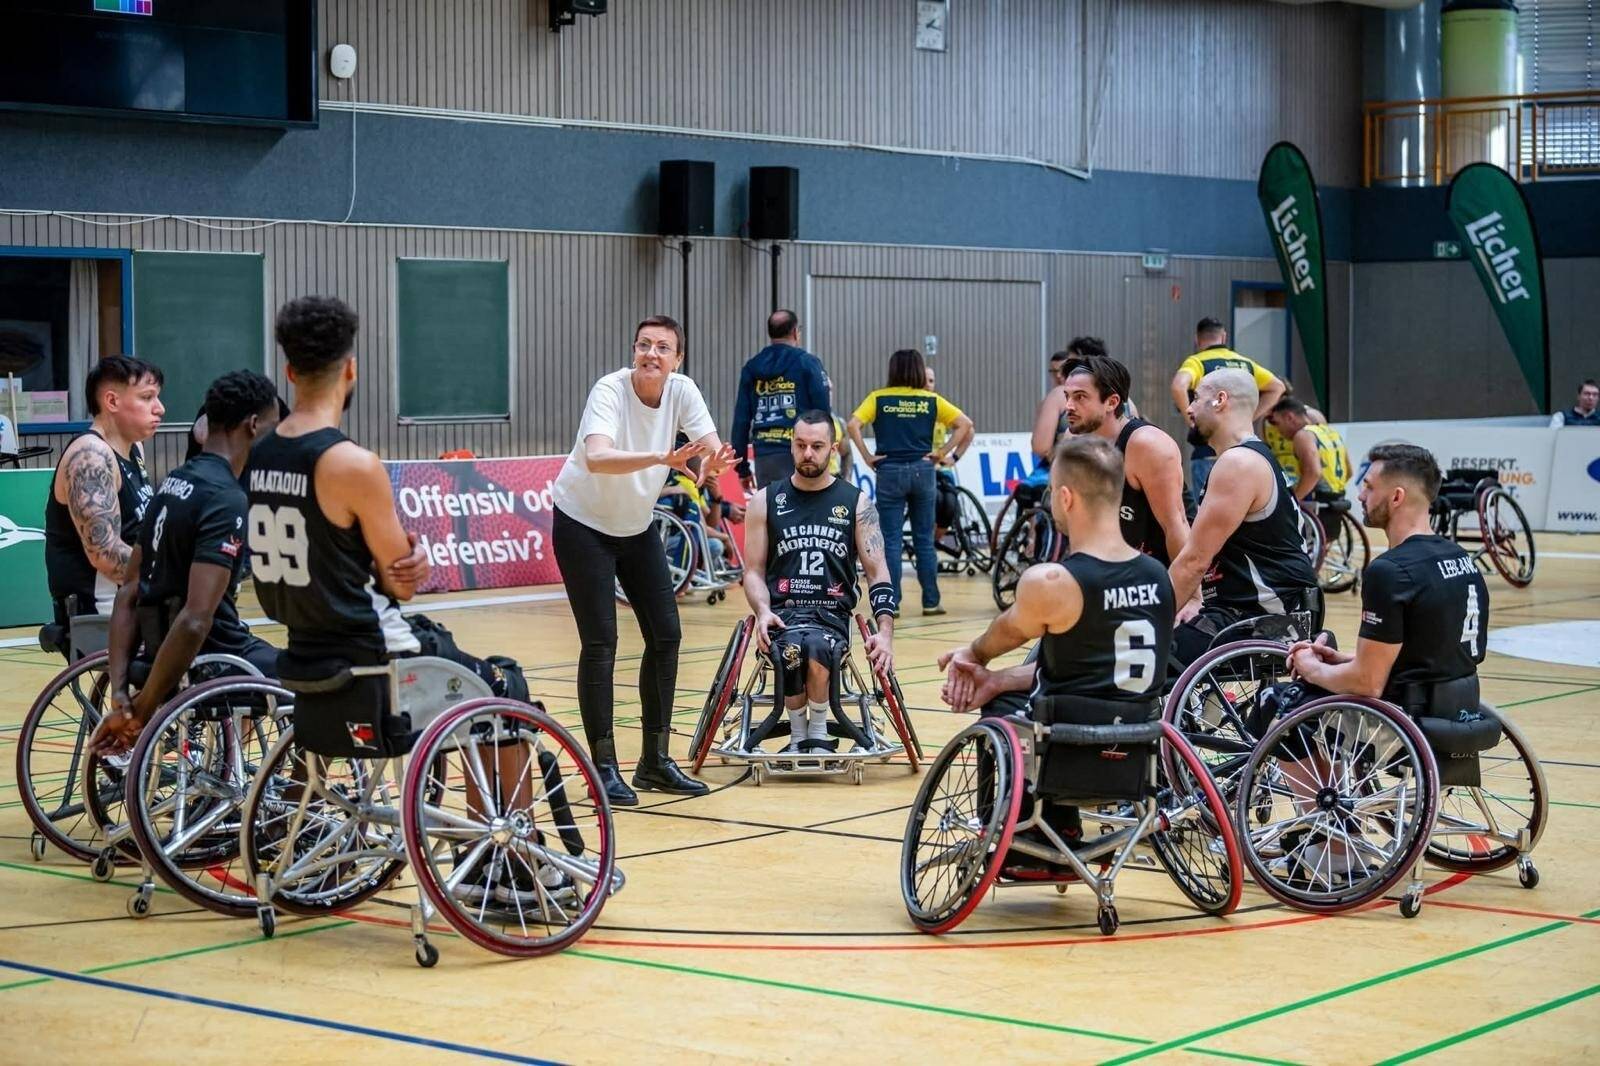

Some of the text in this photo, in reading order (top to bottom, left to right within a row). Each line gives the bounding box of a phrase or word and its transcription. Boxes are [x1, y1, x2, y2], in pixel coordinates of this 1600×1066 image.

[1270, 195, 1316, 292] Licher
[1464, 211, 1530, 301] Licher
[251, 469, 307, 498] MAATAOUI
[400, 484, 515, 518] Offensiv
[236, 516, 243, 530] 9
[783, 524, 842, 540] LE CANNET
[248, 503, 311, 588] 99
[799, 550, 825, 576] 12
[1103, 583, 1161, 611] MACEK
[1460, 584, 1480, 657] 4
[1113, 619, 1157, 694] 6
